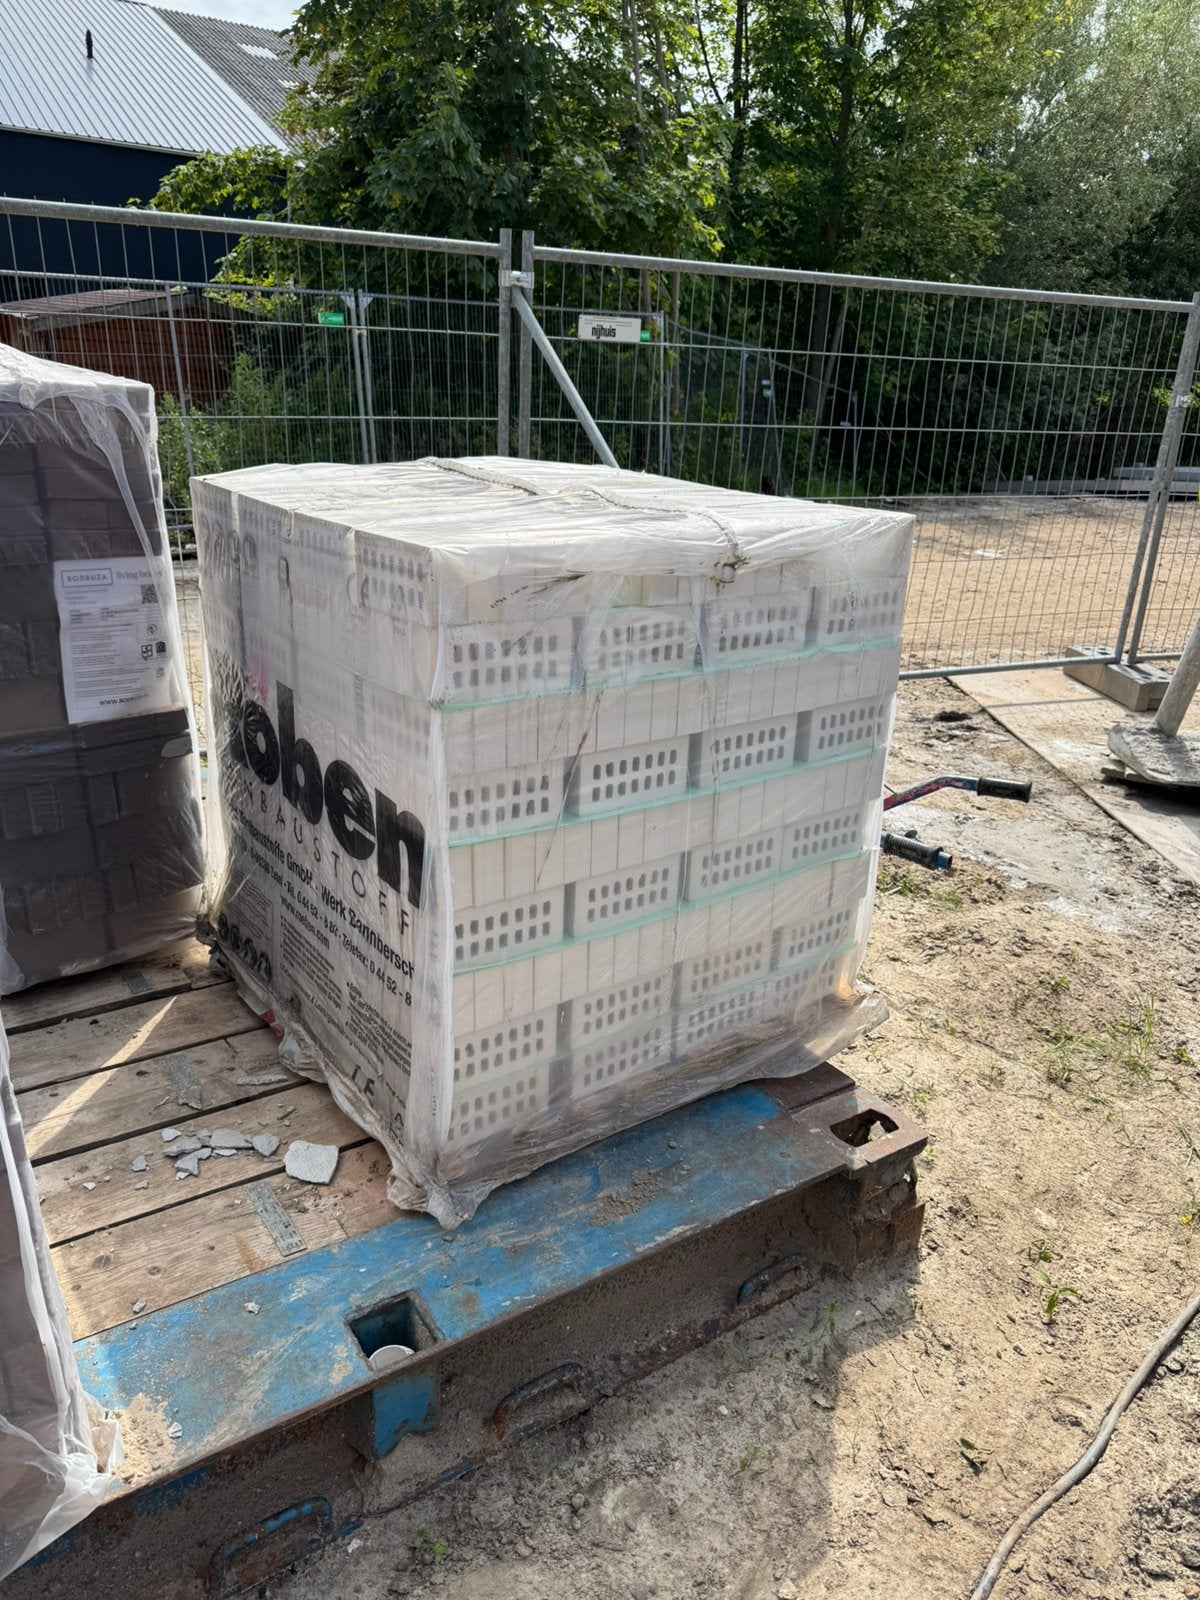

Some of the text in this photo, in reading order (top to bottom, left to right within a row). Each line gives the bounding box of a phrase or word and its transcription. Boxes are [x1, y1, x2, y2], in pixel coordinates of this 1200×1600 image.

[591, 324, 616, 339] nijhuis
[67, 574, 108, 583] RODRUZA
[116, 569, 139, 580] living
[321, 884, 347, 921] Werk
[386, 977, 397, 995] 52
